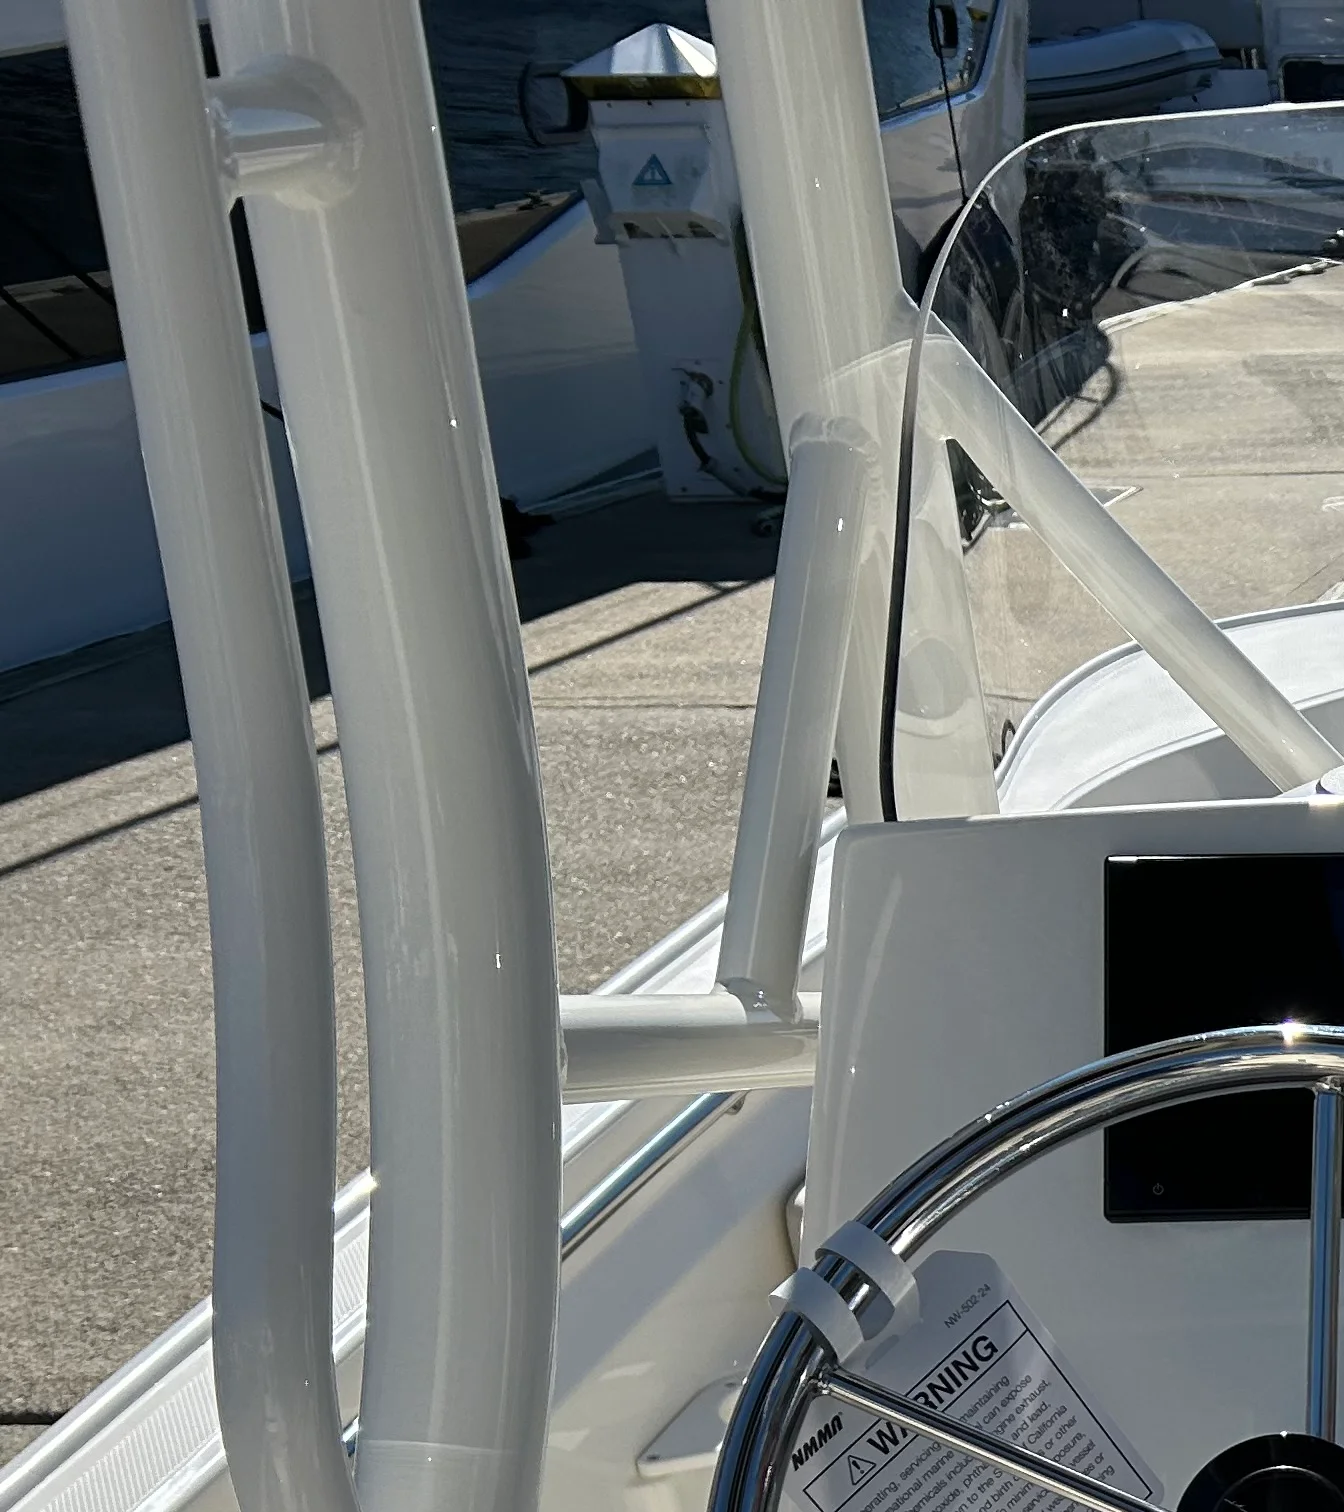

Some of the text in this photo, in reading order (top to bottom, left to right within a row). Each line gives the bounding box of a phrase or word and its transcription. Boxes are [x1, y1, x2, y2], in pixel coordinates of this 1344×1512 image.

[944, 1284, 991, 1328] NW-502-24
[1001, 1375, 1032, 1407] expose
[1011, 1421, 1029, 1441] and
[900, 1441, 942, 1480] servicing
[991, 1480, 1014, 1502] birth
[1055, 1415, 1077, 1440] other
[967, 1492, 979, 1505] to
[978, 1477, 994, 1493] the
